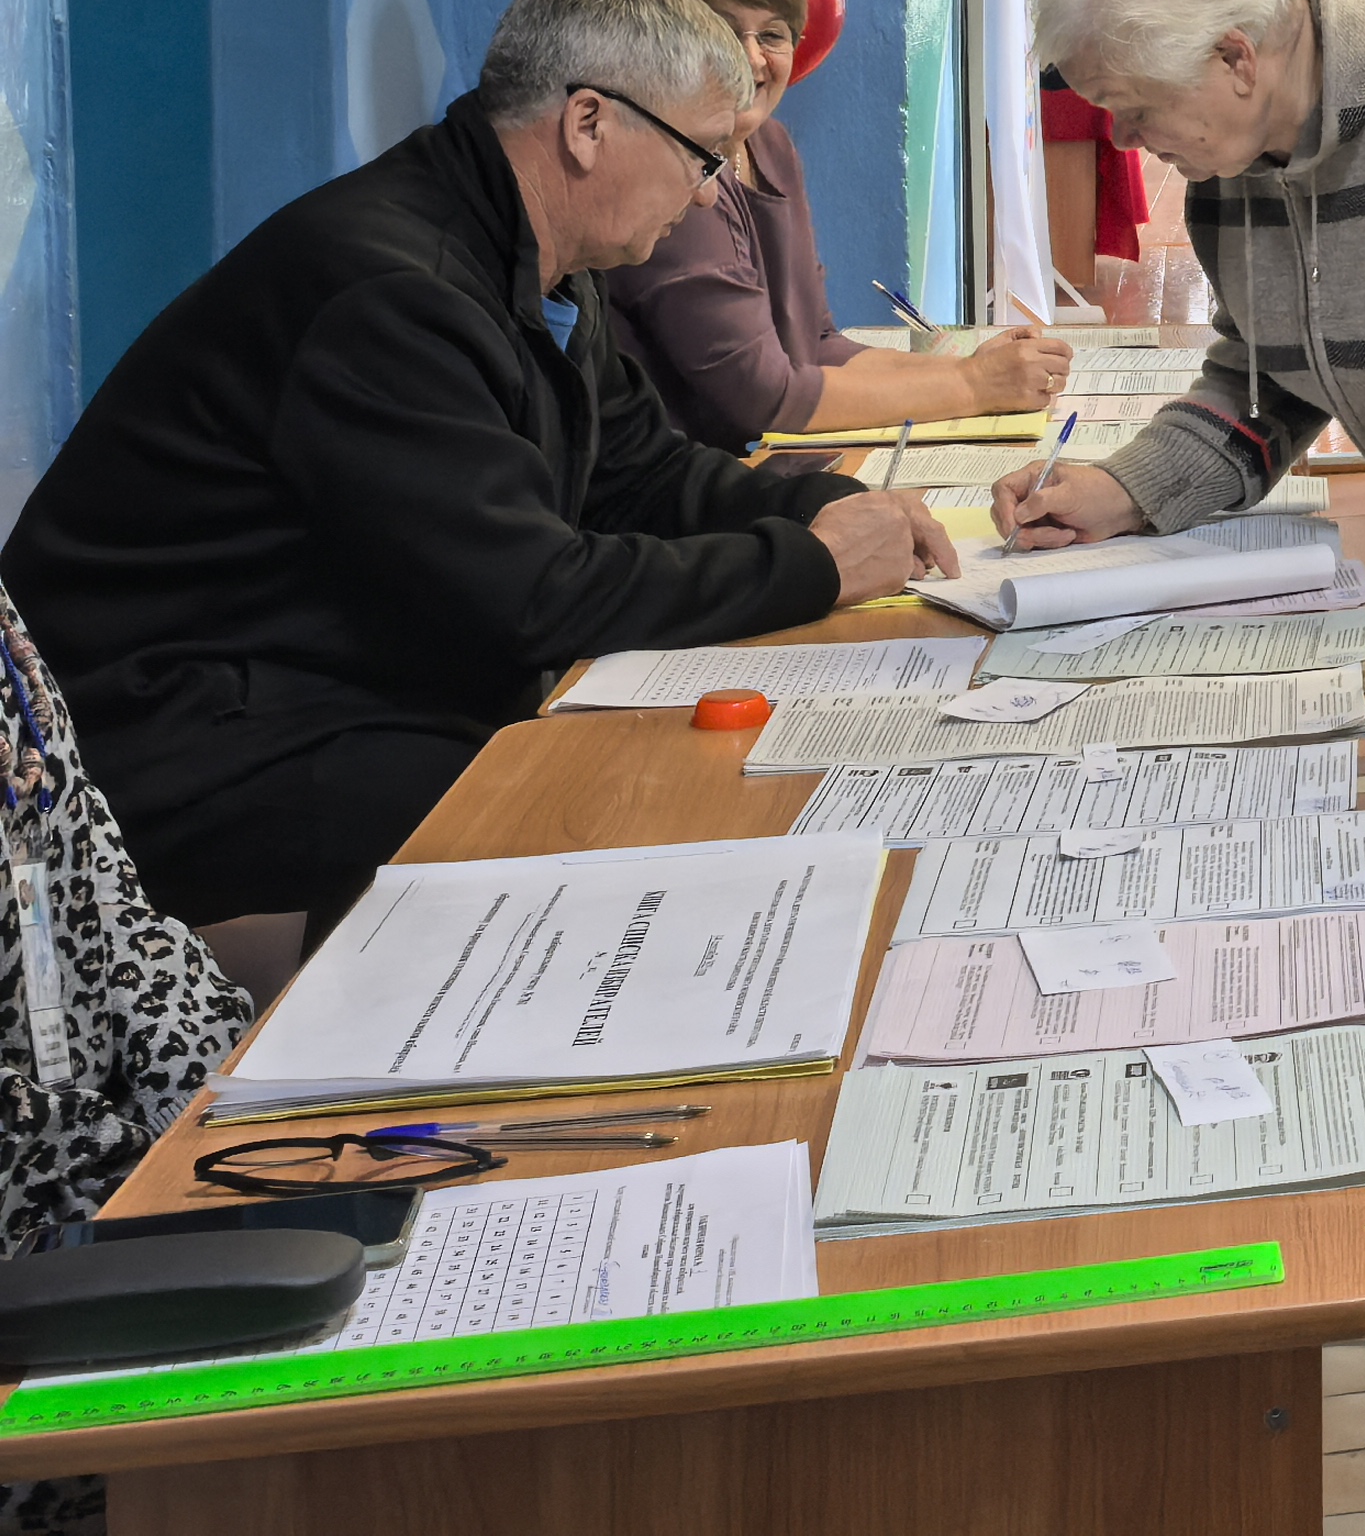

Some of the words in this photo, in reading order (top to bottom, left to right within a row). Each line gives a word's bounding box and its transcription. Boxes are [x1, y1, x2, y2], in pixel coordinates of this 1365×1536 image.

[632, 890, 668, 921] КНИГА
[610, 921, 651, 968] СПИСКА
[571, 968, 632, 1046] ИЗБИРАТЕЛЕЙ
